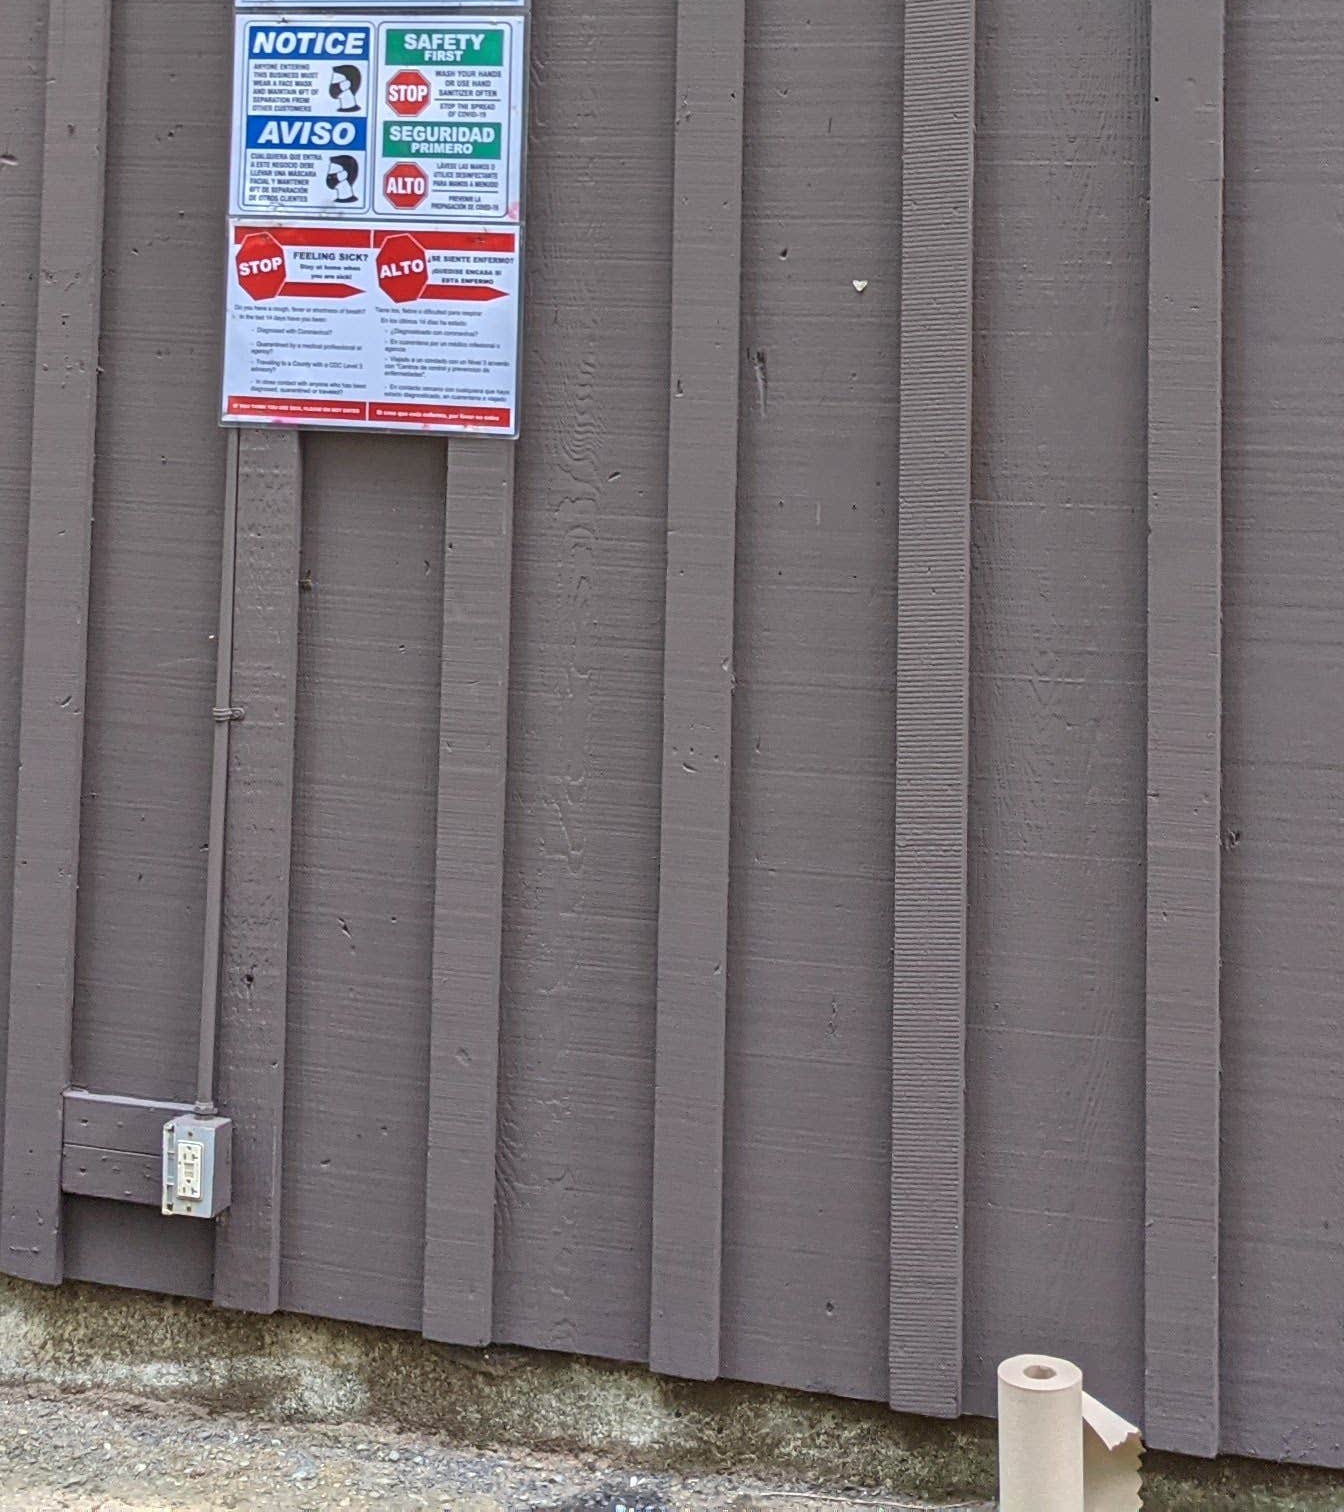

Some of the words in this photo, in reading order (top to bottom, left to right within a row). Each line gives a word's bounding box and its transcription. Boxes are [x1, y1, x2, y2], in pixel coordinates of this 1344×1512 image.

[252, 32, 366, 54] NOTICE
[404, 33, 485, 50] SAFETY
[424, 51, 463, 61] FIRST
[389, 84, 427, 102] STOP
[257, 121, 356, 145] AVISO
[389, 126, 495, 143] SEGURIDAD
[411, 143, 473, 154] PRIMERO
[386, 177, 425, 194] ALTO
[293, 252, 336, 260] FEELING
[339, 253, 368, 262] SICK?
[239, 257, 282, 276] STOP
[380, 259, 424, 279] ALTO
